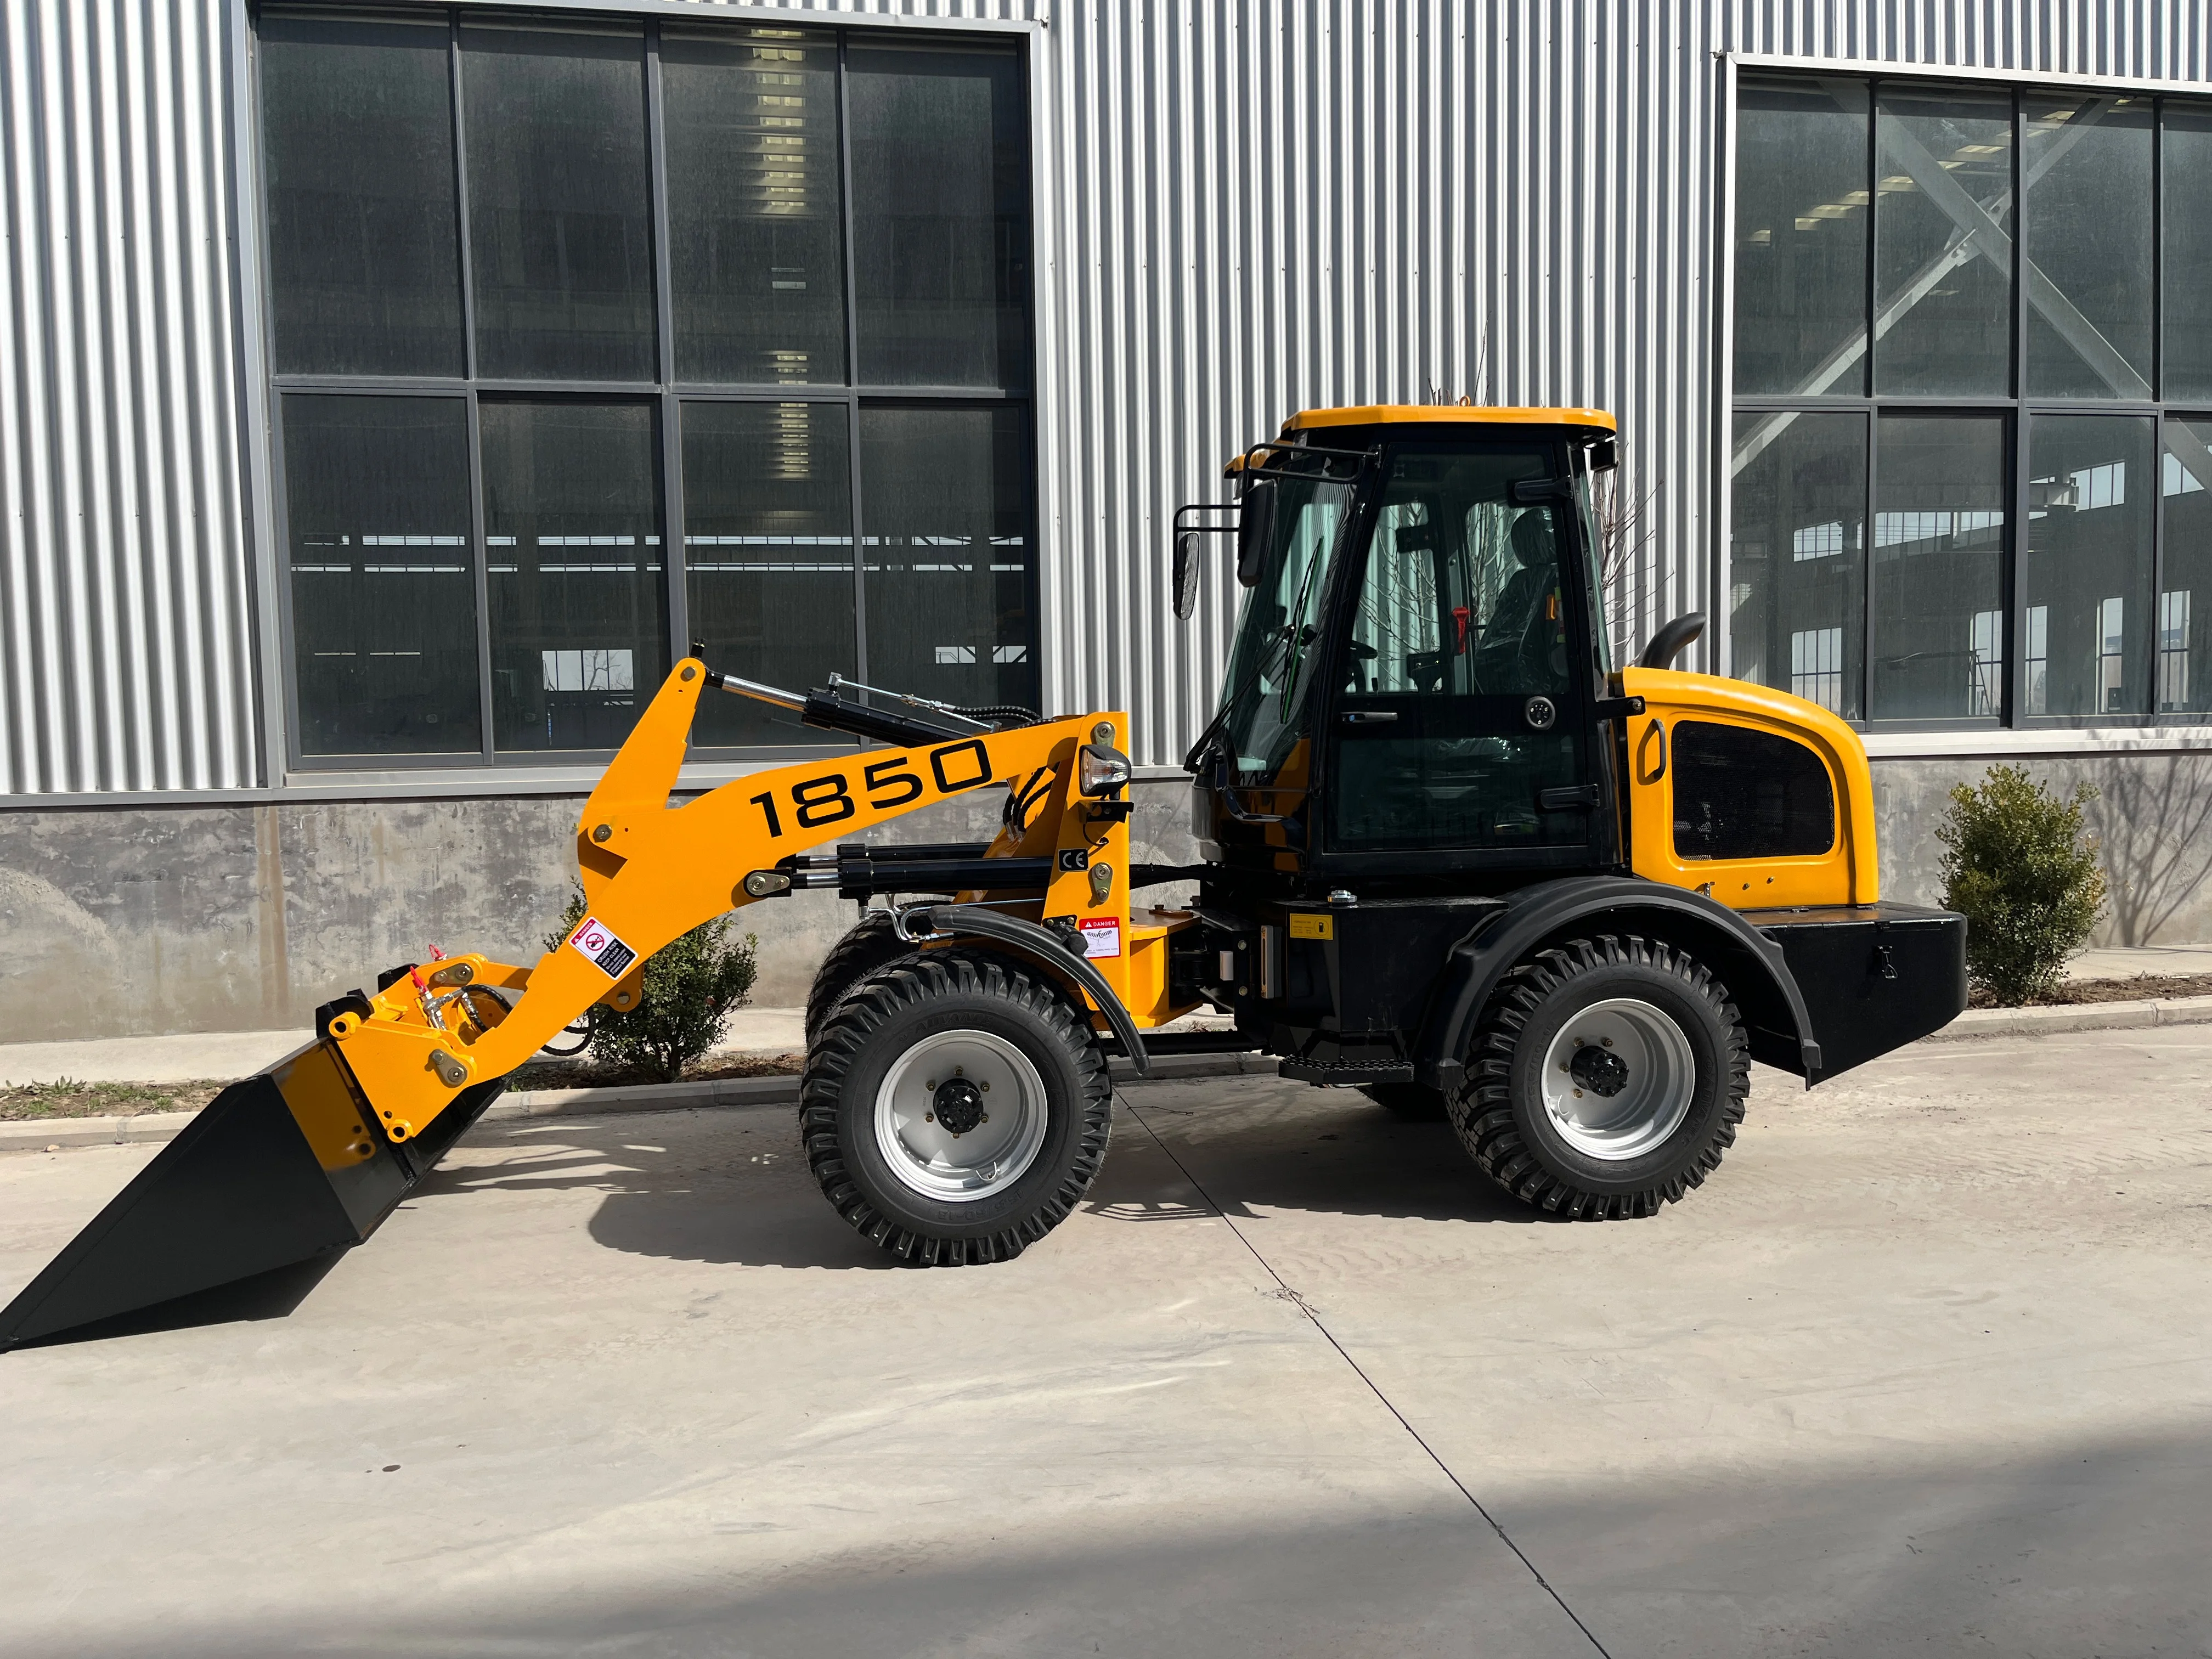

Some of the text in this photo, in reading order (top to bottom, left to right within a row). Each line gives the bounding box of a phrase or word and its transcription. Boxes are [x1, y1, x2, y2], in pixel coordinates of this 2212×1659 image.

[750, 740, 992, 838] 1850
[1063, 851, 1085, 868] CE
[579, 922, 593, 936] DANGER
[597, 941, 618, 963] CRUSH RISK
[602, 947, 620, 967] KEEP CLEAR
[915, 1012, 995, 1034] ADVANCE
[1680, 1075, 1714, 1148] ADVANCE
